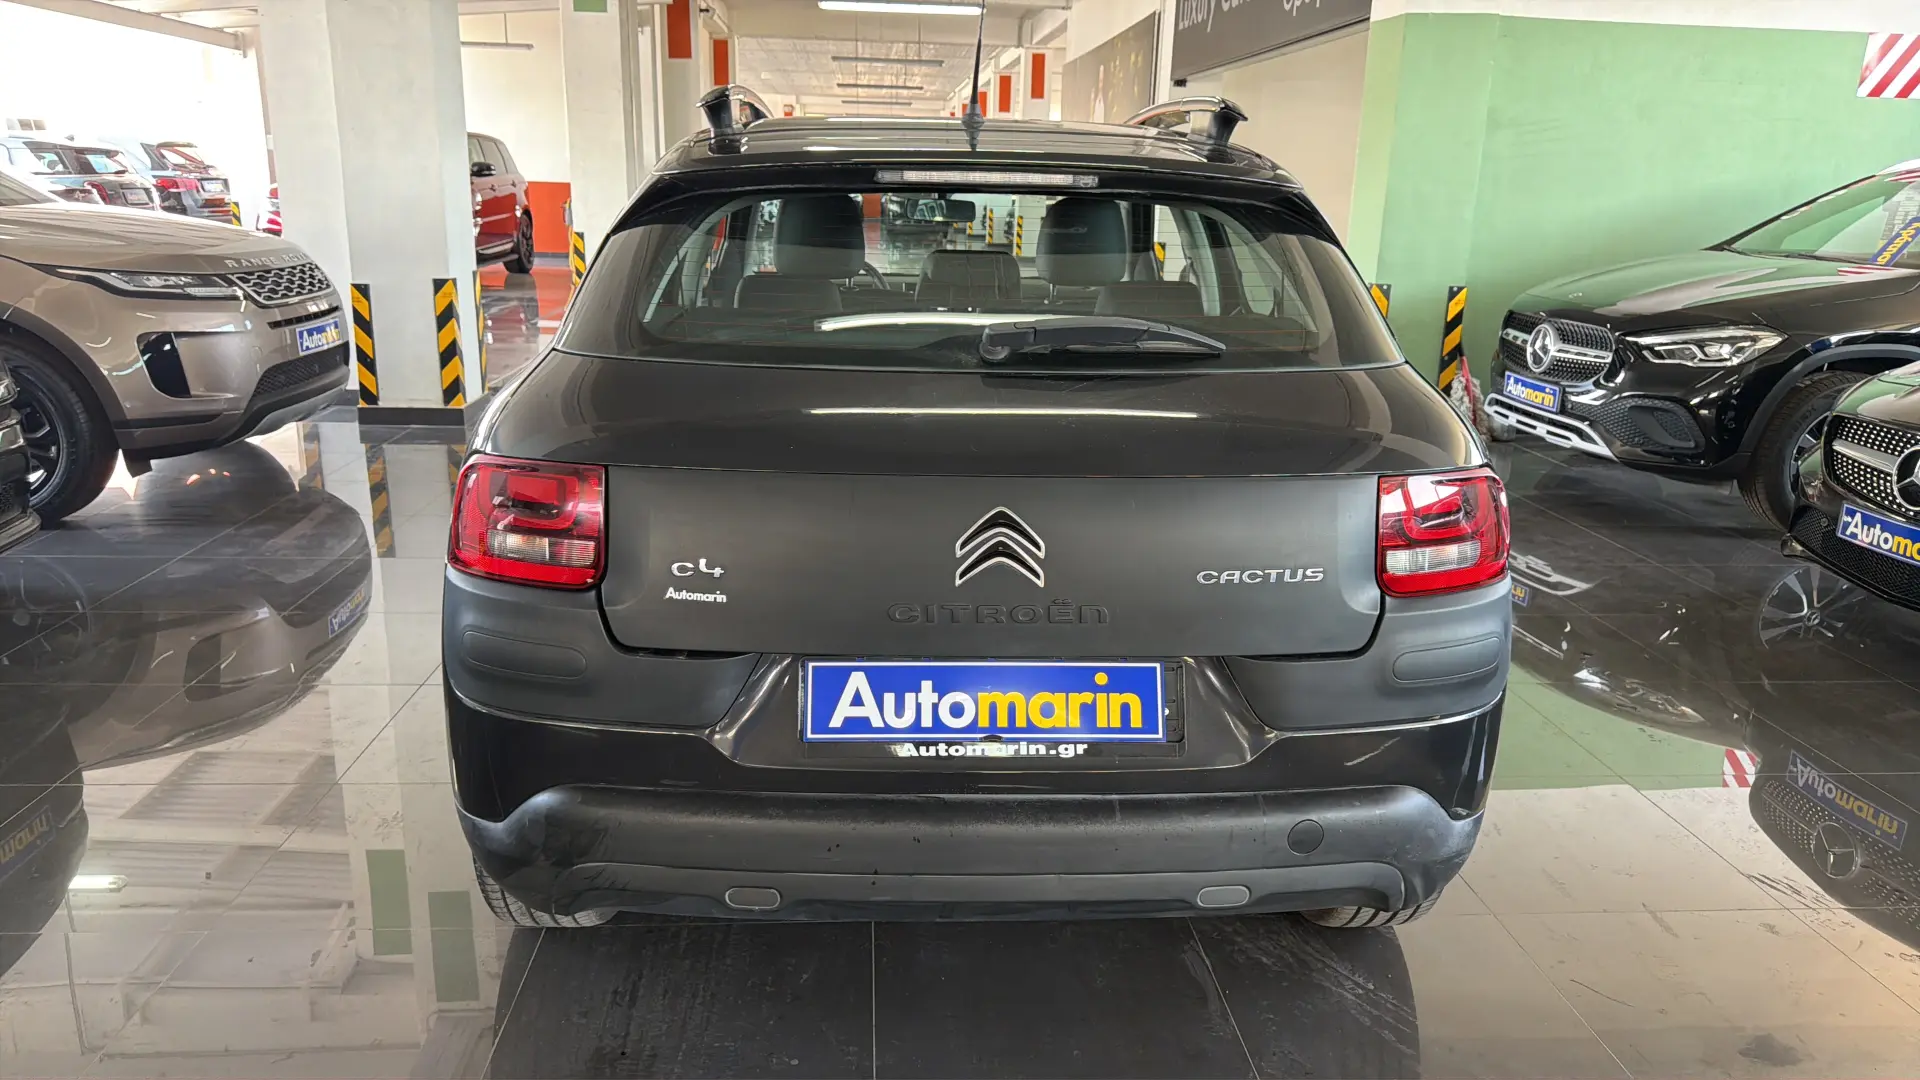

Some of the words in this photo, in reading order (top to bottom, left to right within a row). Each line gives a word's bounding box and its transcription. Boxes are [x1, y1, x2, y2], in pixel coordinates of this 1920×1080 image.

[1178, 0, 1216, 33] Luxury
[1506, 375, 1555, 408] Automarin
[1196, 567, 1324, 584] CACTUS
[663, 586, 727, 603] Automarin
[828, 670, 1143, 729] Automarin
[898, 741, 1088, 758] Automarin.gr
